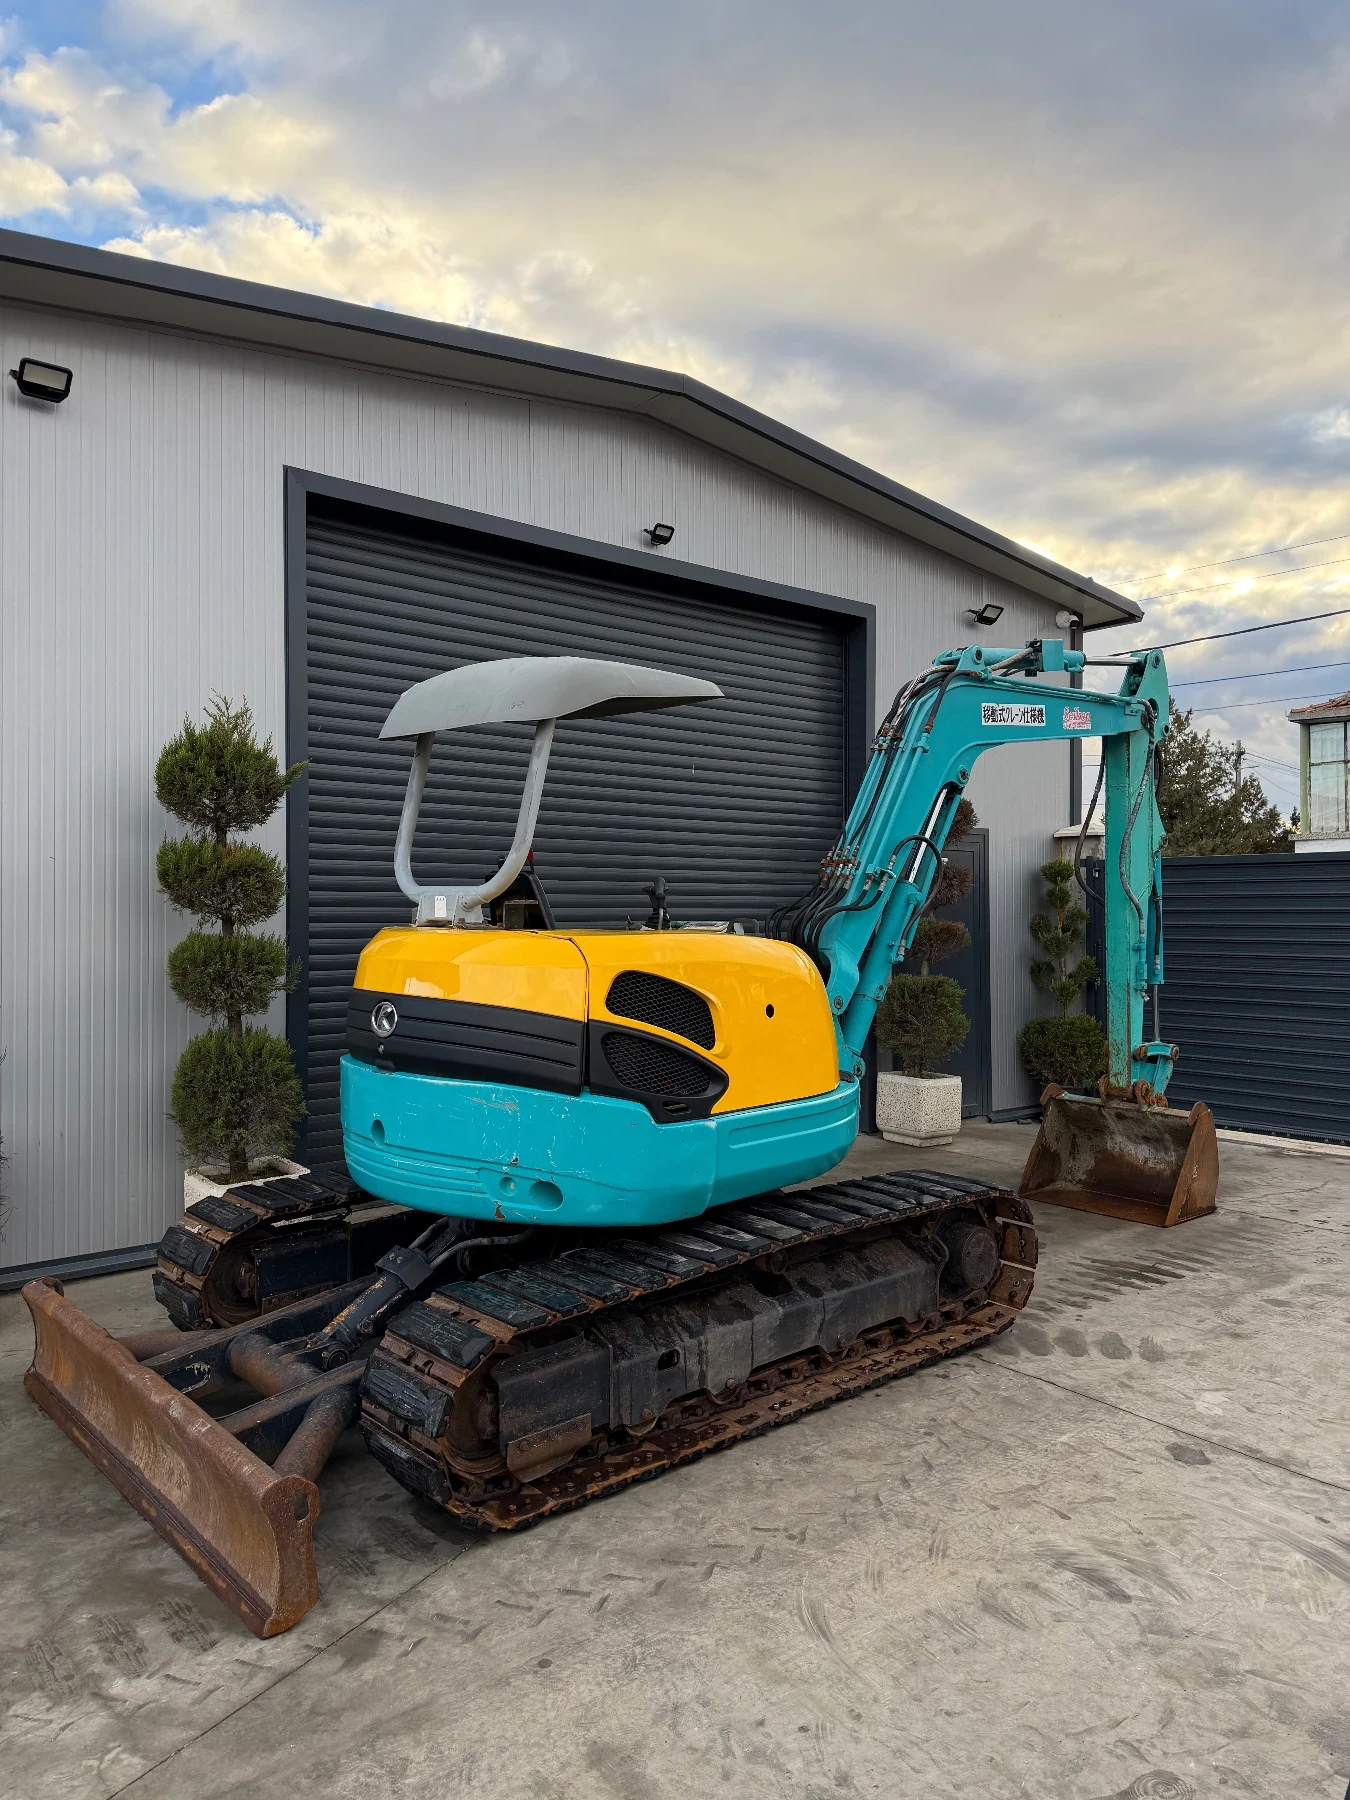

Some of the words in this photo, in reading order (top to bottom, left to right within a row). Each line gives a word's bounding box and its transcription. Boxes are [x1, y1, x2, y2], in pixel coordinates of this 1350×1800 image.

[983, 705, 1045, 724] 移動式クレーン仕様機
